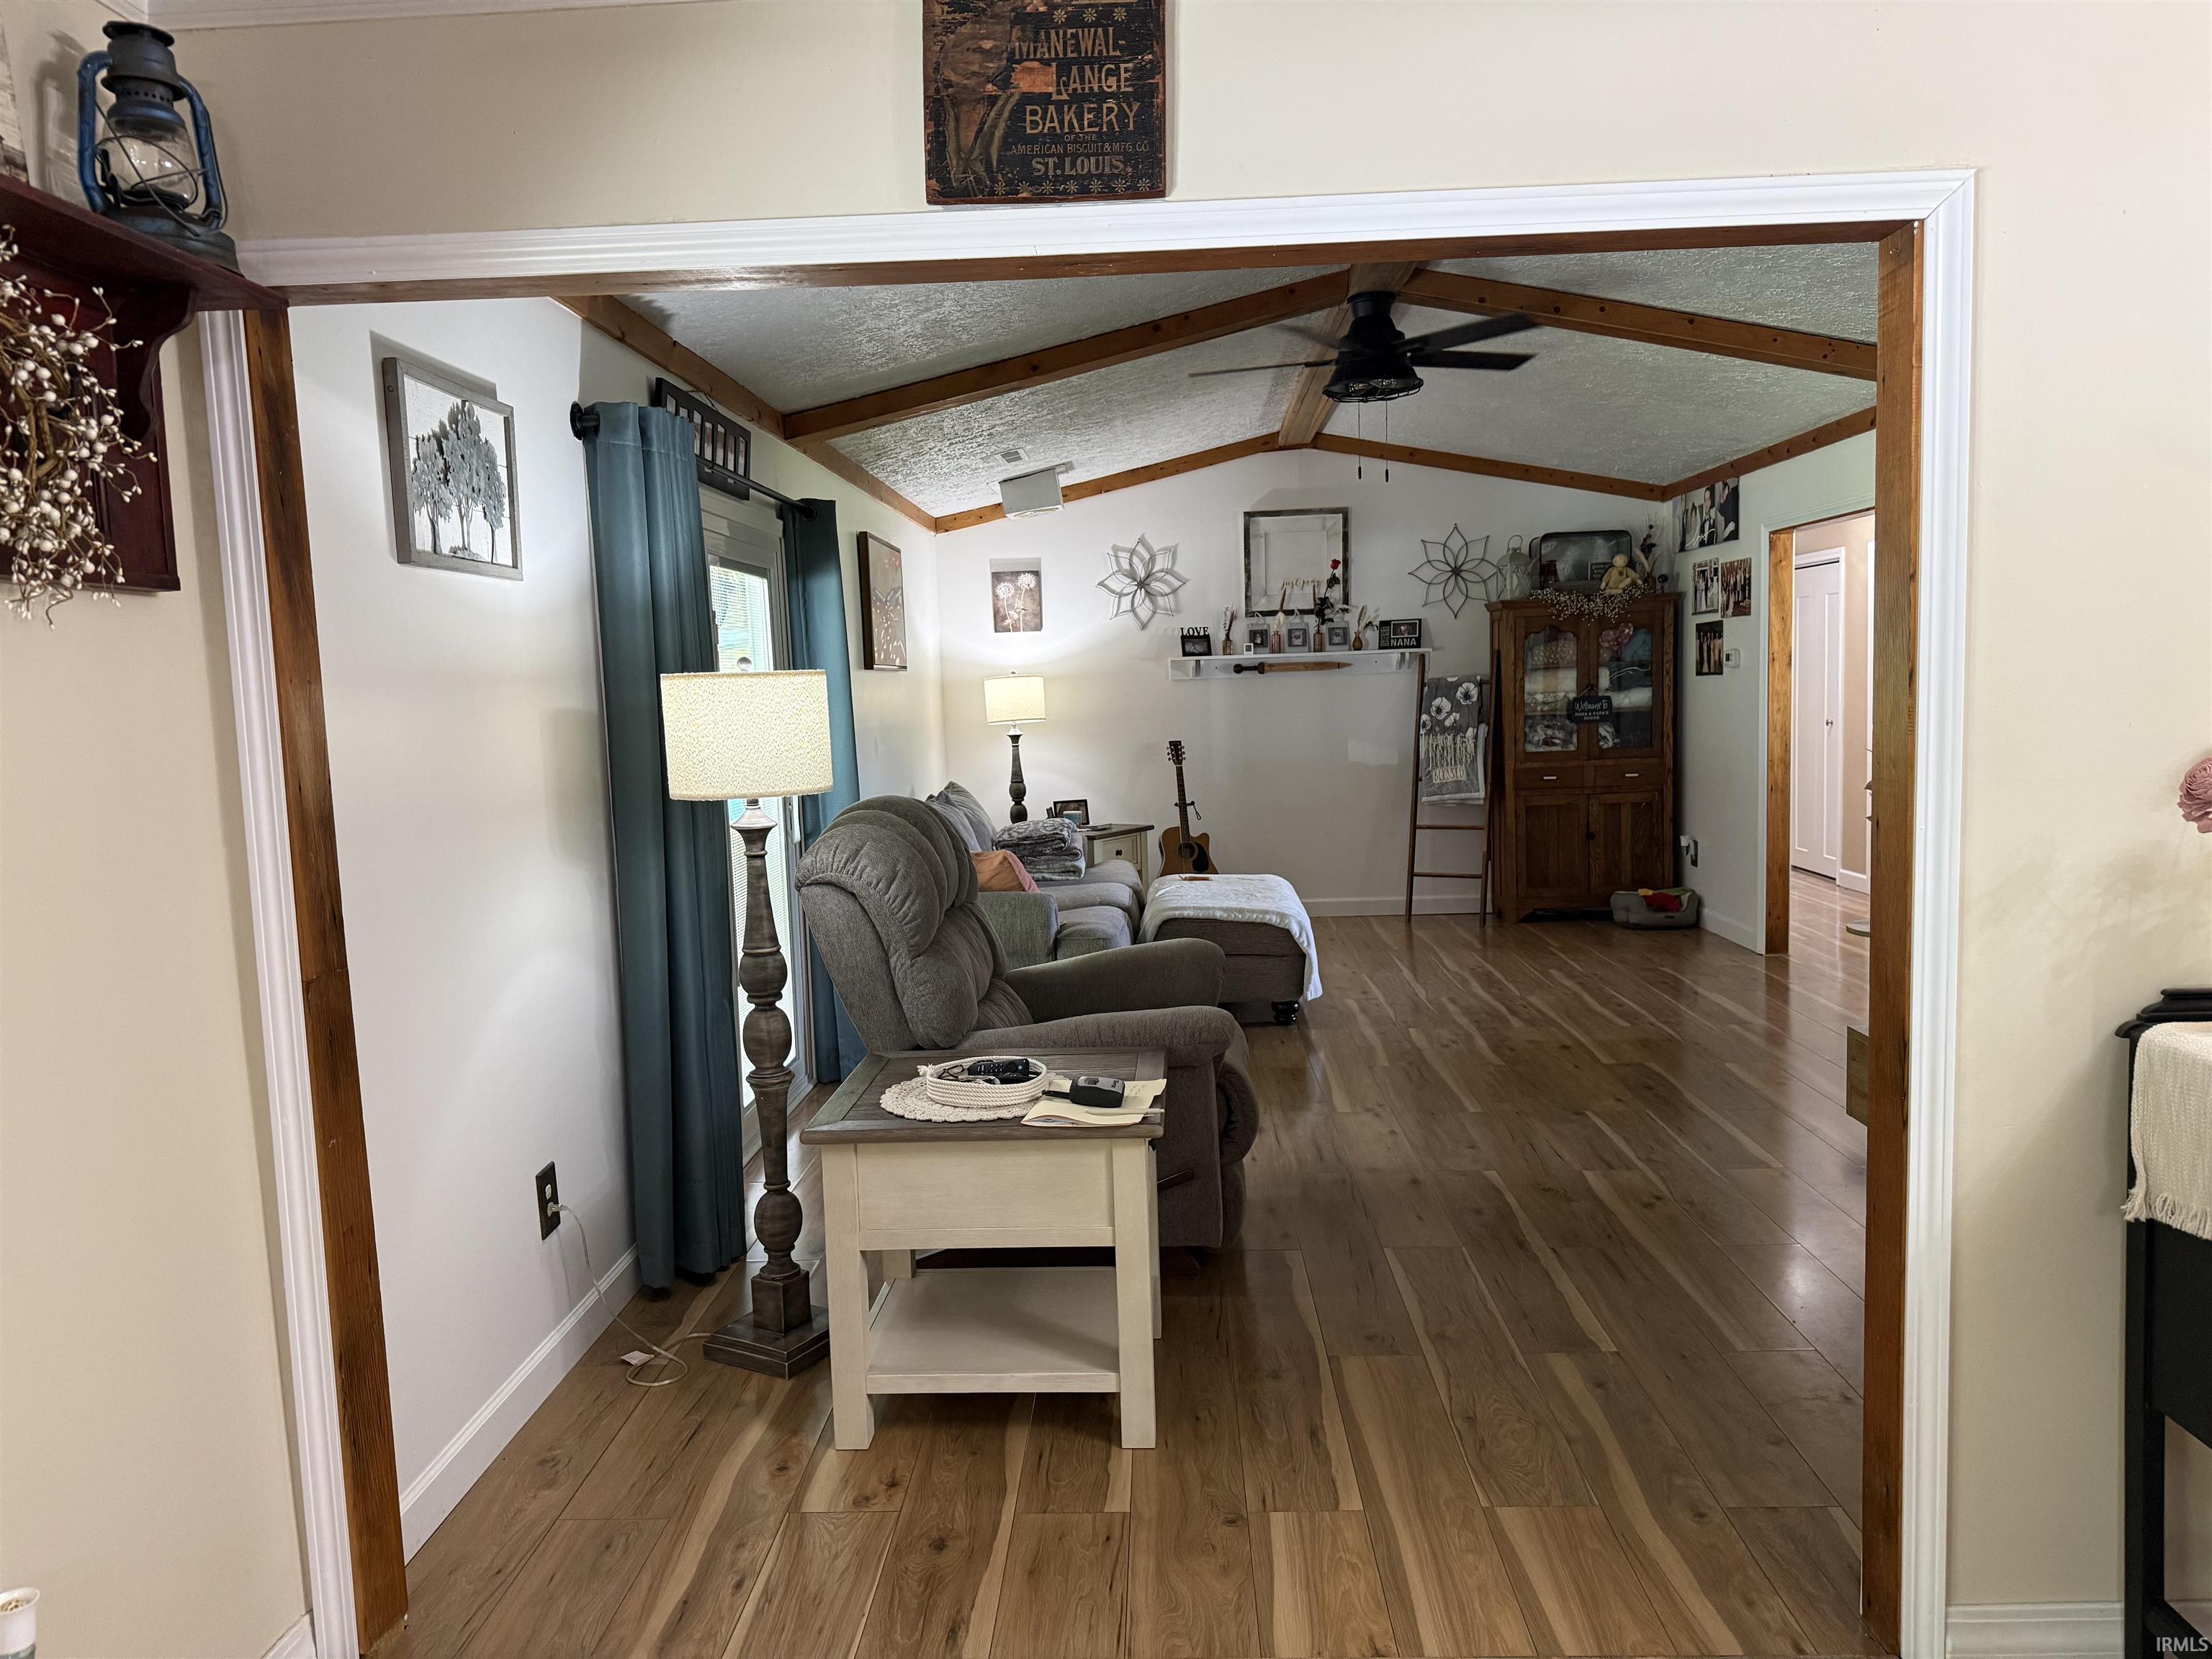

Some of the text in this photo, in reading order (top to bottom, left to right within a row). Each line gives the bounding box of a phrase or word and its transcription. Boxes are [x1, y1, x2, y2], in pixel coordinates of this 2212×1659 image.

[1050, 62, 1135, 100] LANGE
[1025, 102, 1141, 134] BAKERY
[1010, 143, 1064, 155] AMERICAN
[1032, 154, 1125, 176] ST. LOUIS
[1180, 626, 1210, 637] LOVE
[1390, 637, 1417, 647] NANA
